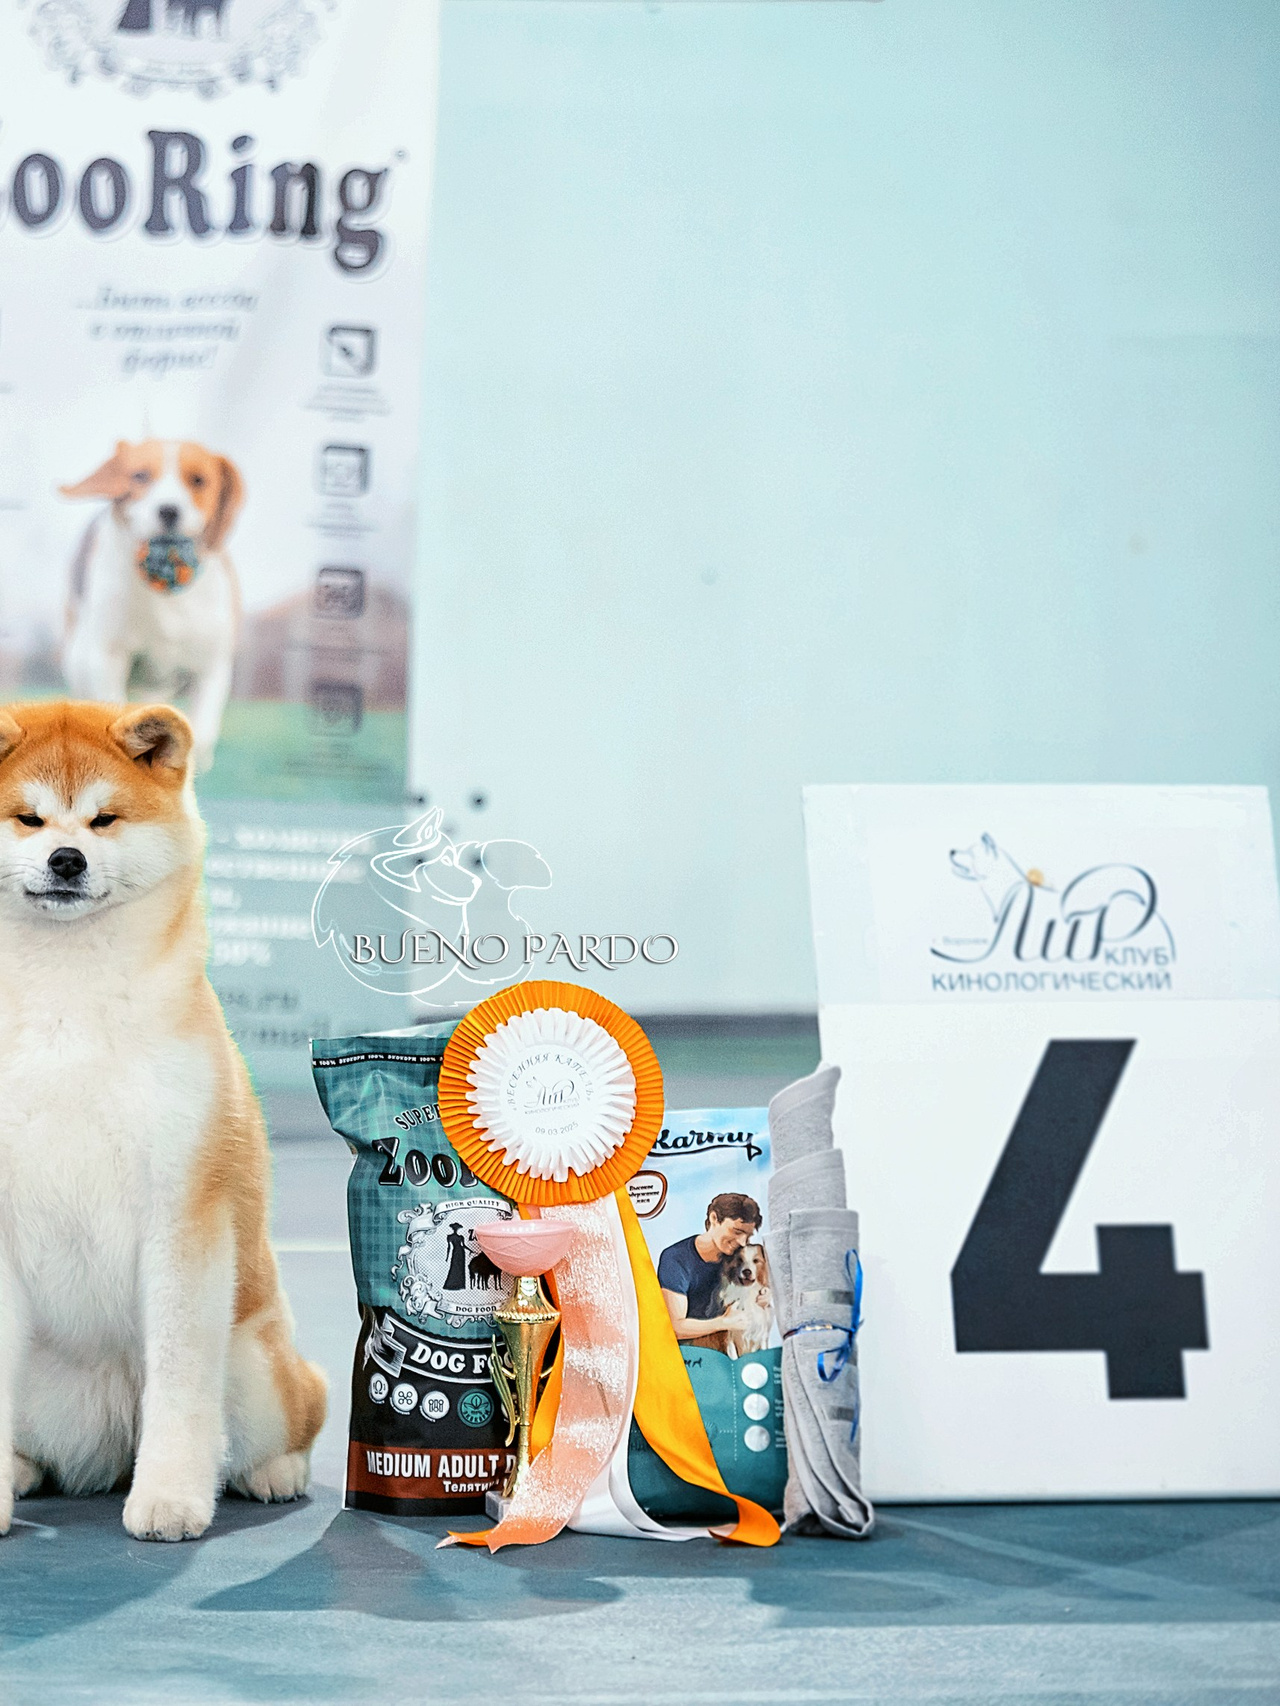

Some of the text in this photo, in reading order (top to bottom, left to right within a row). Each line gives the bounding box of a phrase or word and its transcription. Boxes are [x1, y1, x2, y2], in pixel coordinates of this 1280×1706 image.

[1104, 946, 1169, 967] КЛУБ
[931, 969, 1173, 992] КИНОЛОГИЧЕСКИЙ
[466, 1199, 500, 1207] QUALITY
[950, 1038, 1210, 1400] 4
[475, 1305, 497, 1313] FOOD
[410, 1342, 466, 1373] DOG
[366, 1450, 431, 1478] MEDIUM
[437, 1455, 499, 1478] ADULT
